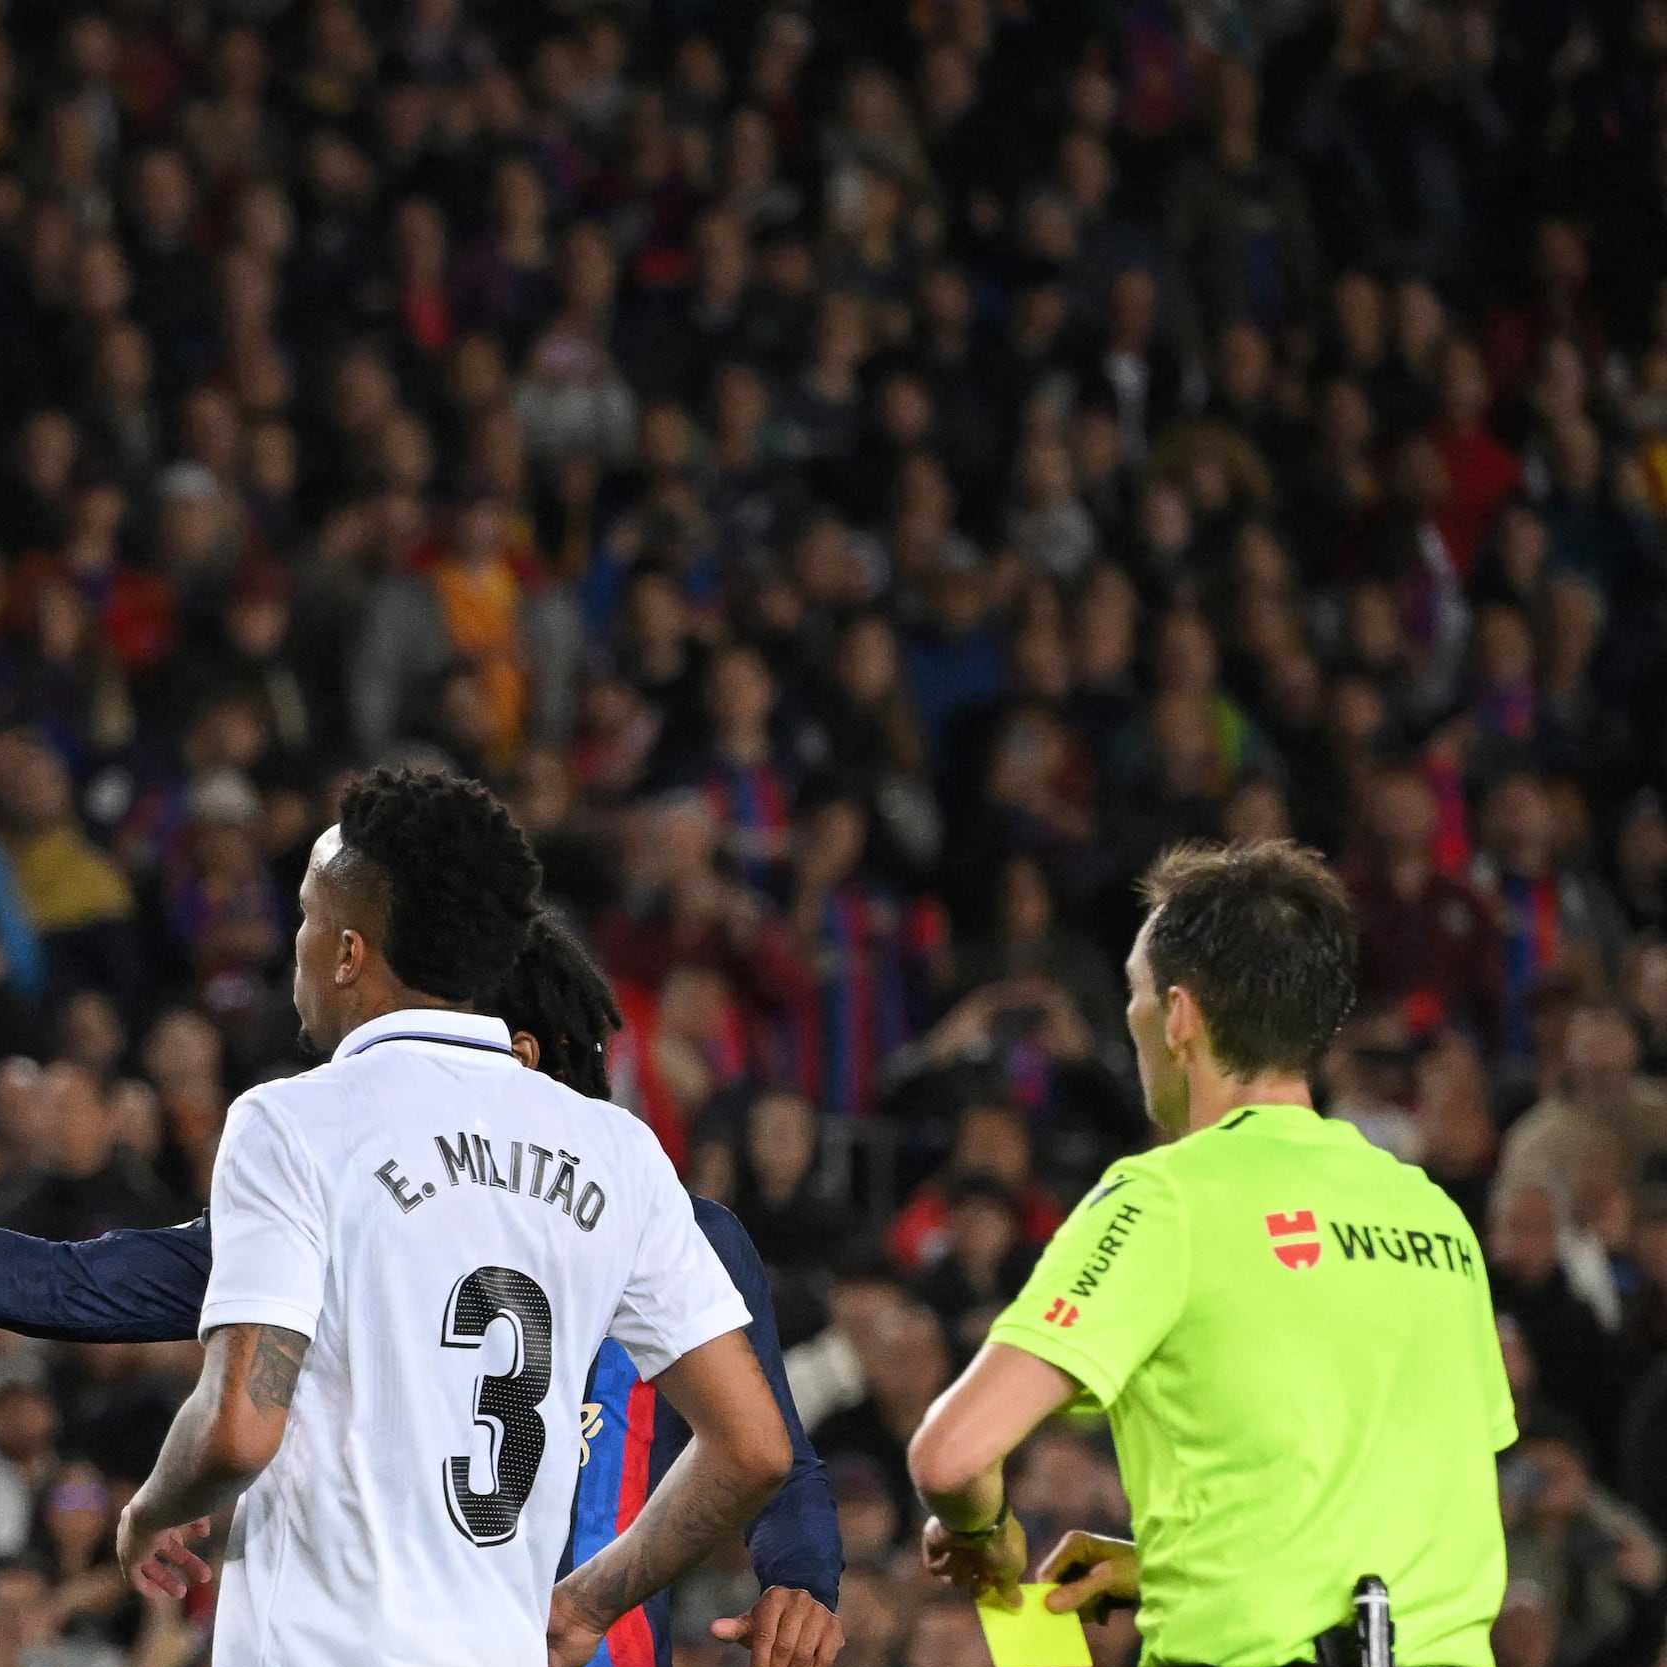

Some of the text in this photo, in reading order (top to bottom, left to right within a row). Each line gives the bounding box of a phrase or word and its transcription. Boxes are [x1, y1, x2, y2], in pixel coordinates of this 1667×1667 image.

[374, 1132, 606, 1232] E. MILITÃO
[1070, 1204, 1142, 1297] WÜRTH
[1330, 1221, 1476, 1281] WÜRTH
[441, 1266, 552, 1548] 3
